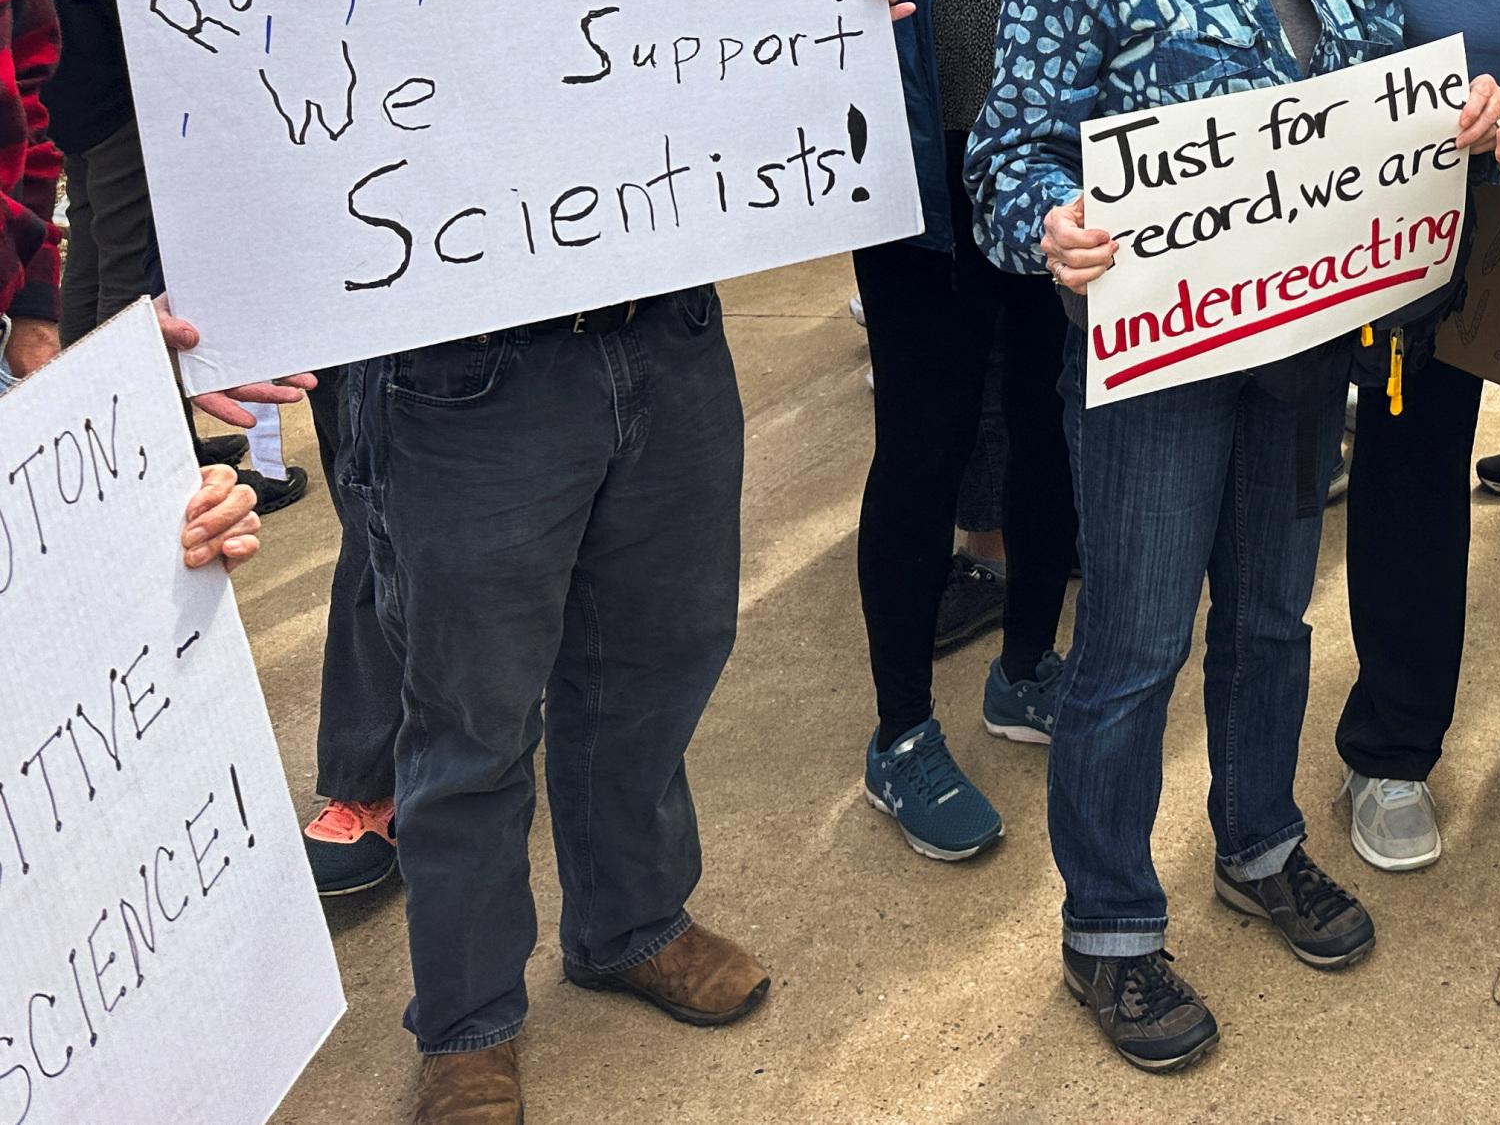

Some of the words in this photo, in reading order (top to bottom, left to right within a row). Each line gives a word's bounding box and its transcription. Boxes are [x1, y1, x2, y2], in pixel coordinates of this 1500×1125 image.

[258, 40, 436, 146] We
[562, 6, 864, 84] Support
[1088, 115, 1237, 204] Just
[1258, 97, 1350, 151] for
[1374, 66, 1468, 122] the
[344, 103, 871, 291] Scientists!
[1378, 136, 1463, 188] are
[1091, 209, 1461, 361] underreacting
[0, 393, 147, 594] TON,
